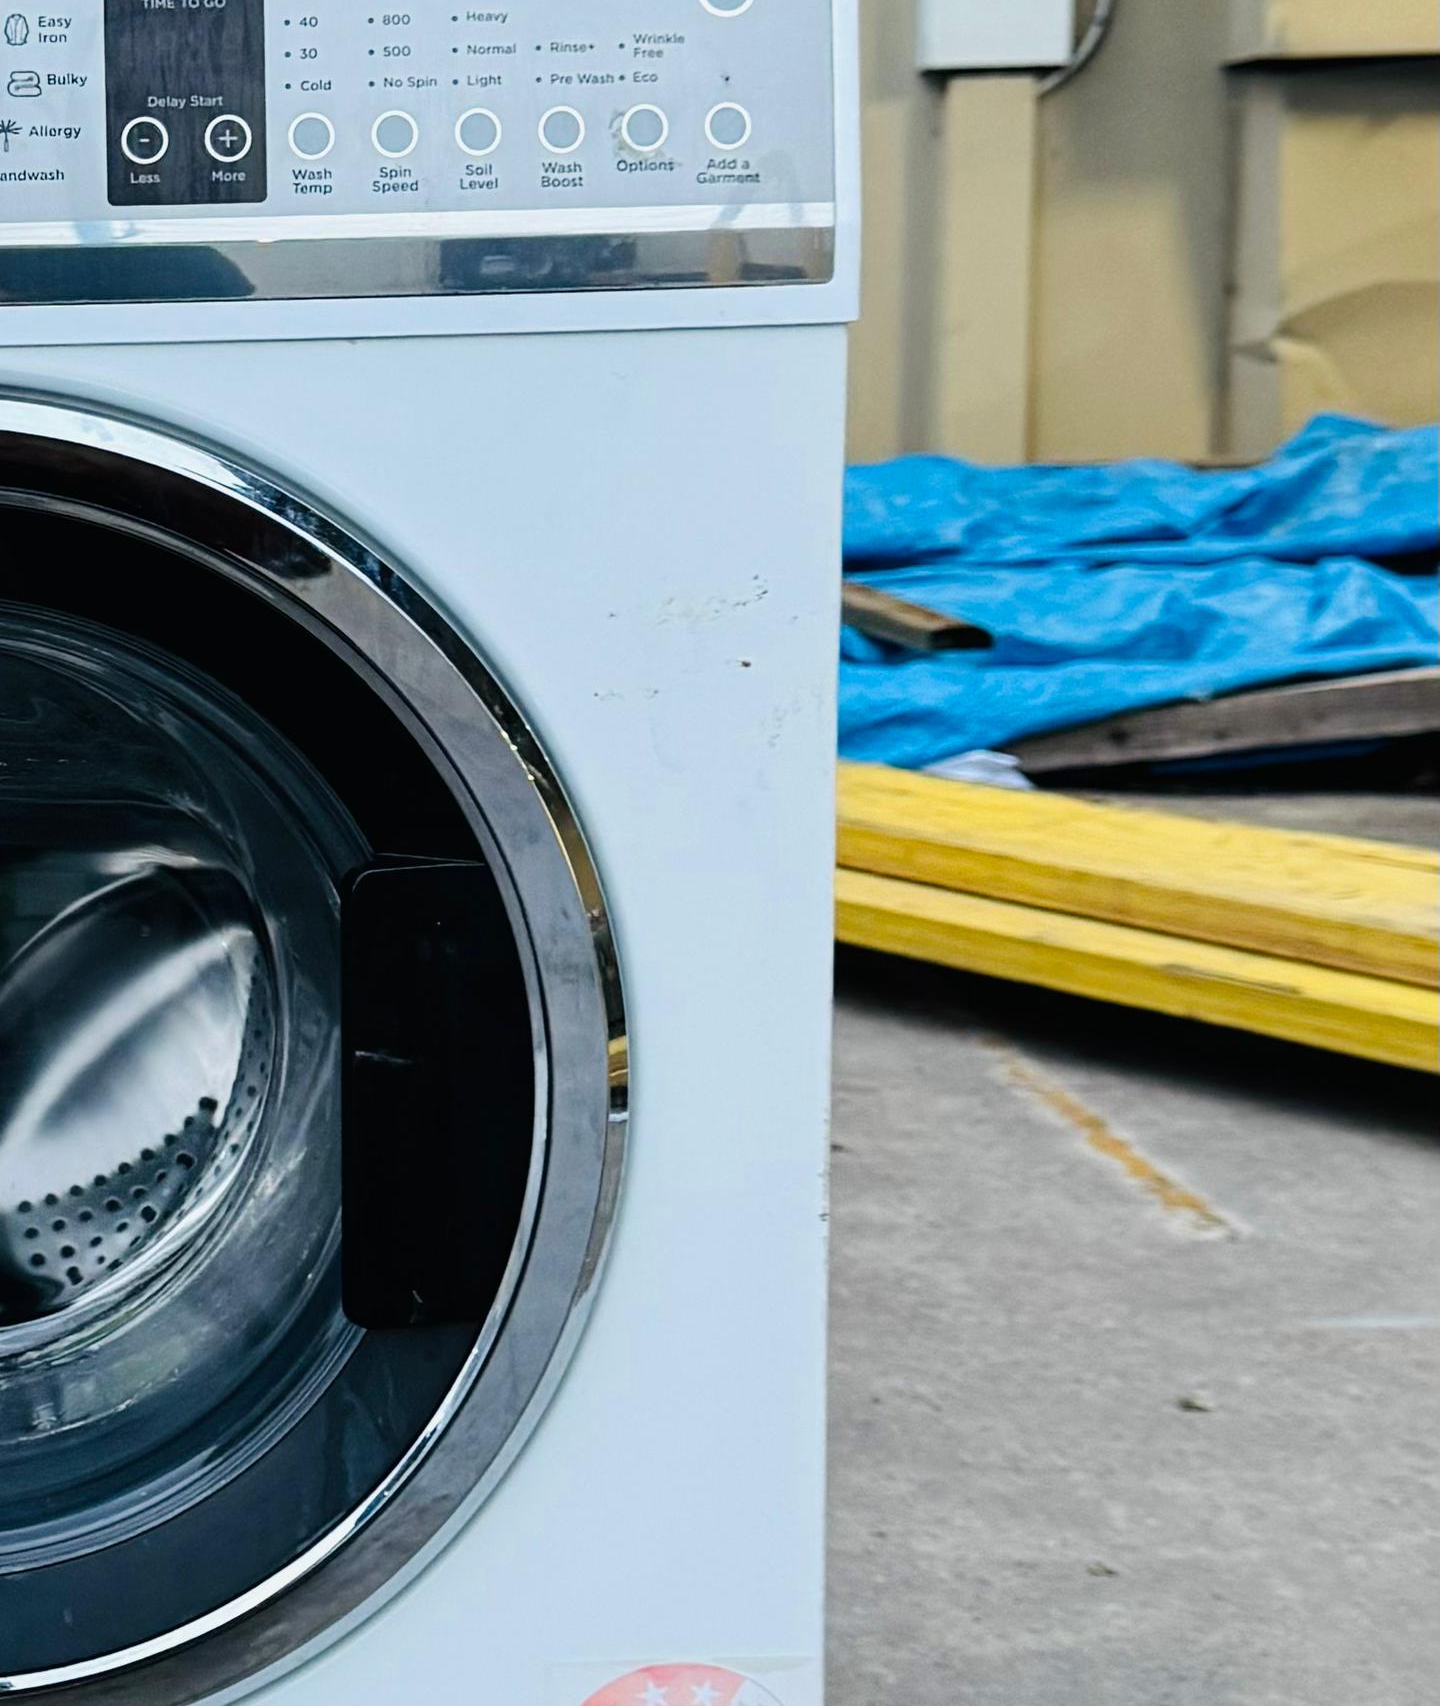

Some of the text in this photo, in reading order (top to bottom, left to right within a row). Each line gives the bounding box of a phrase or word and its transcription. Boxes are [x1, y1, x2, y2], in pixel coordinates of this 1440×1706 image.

[38, 15, 72, 30] Easy
[299, 16, 318, 28] 40
[383, 14, 411, 26] 800
[467, 11, 508, 24] Heavy
[38, 31, 67, 43] Iron
[633, 33, 685, 44] Wrinkle
[299, 48, 318, 60] 30
[383, 45, 411, 58] 500
[467, 42, 516, 55] Normal
[633, 47, 664, 59] Free
[47, 73, 88, 88] Bulky
[383, 75, 438, 89] No Spin
[467, 74, 502, 88] Light
[550, 72, 615, 85] Pre Wash
[633, 72, 658, 83] Eco
[300, 80, 332, 92] Cold
[147, 95, 223, 109] Delay Start
[29, 124, 81, 139] Allergy
[465, 164, 493, 176] Soil
[542, 162, 582, 174] Wash
[616, 159, 674, 173] Options
[707, 159, 750, 171] Add a
[130, 173, 160, 184] Less
[212, 171, 246, 182] More
[292, 168, 332, 181] Wash
[380, 166, 412, 180] Spin
[696, 172, 760, 184] Garment
[372, 180, 419, 194] Speed
[460, 178, 498, 189] Level
[541, 176, 583, 188] Boost
[293, 182, 333, 195] Temp
